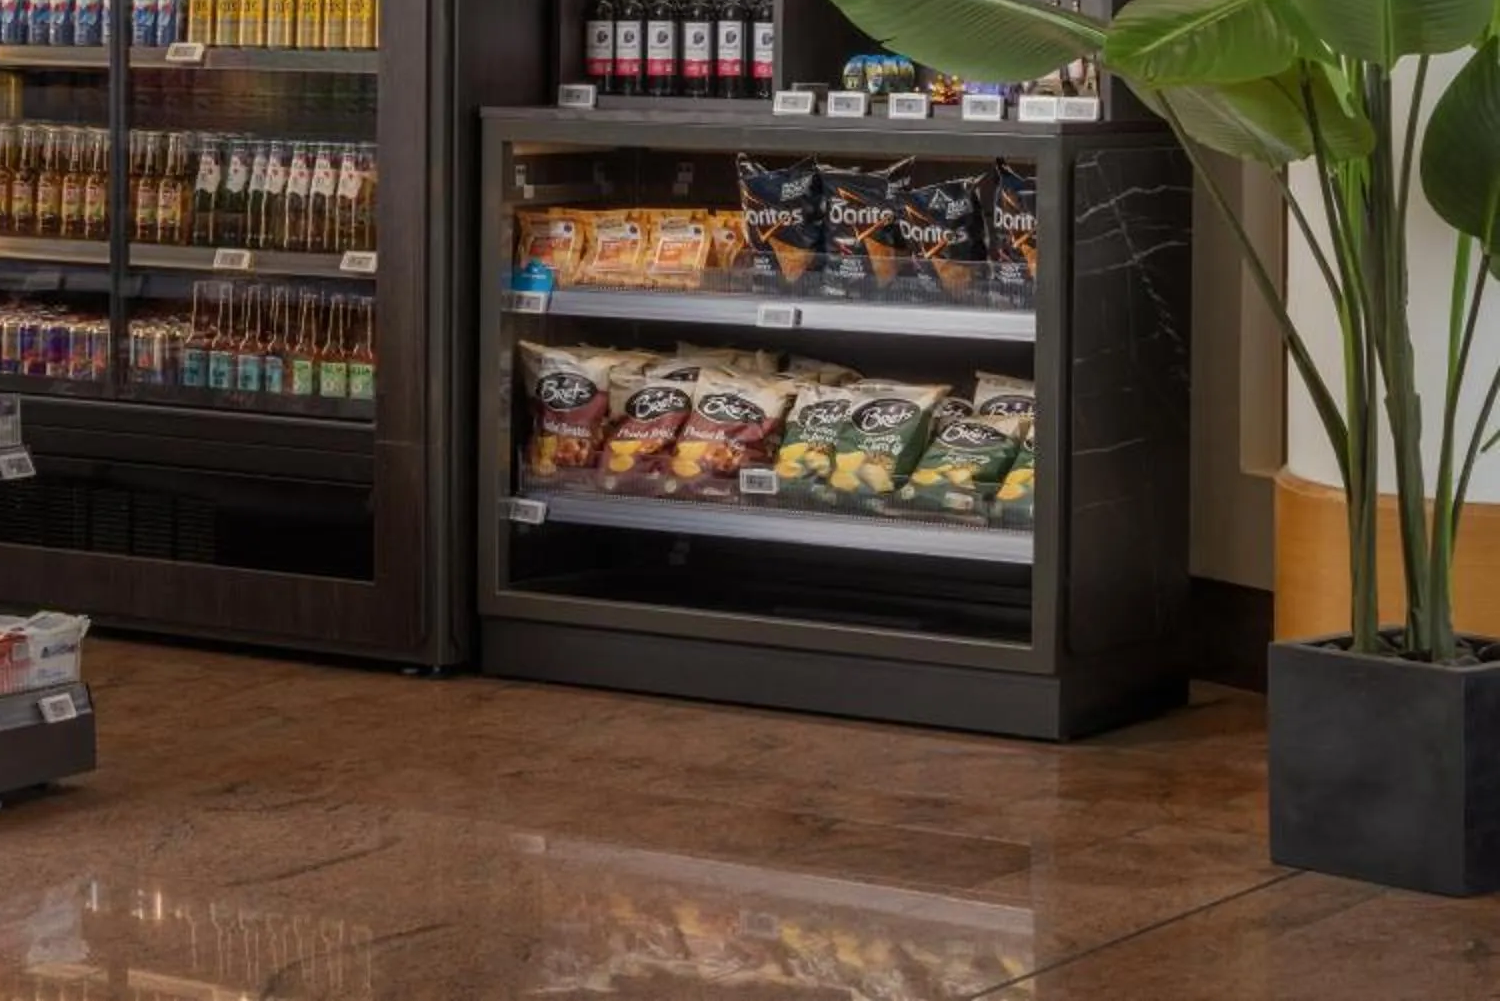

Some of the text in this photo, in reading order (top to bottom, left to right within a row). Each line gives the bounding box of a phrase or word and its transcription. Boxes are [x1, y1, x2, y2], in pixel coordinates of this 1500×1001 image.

[747, 207, 803, 226] oritos
[994, 207, 1037, 230] Dorit
[900, 220, 969, 243] Doritos
